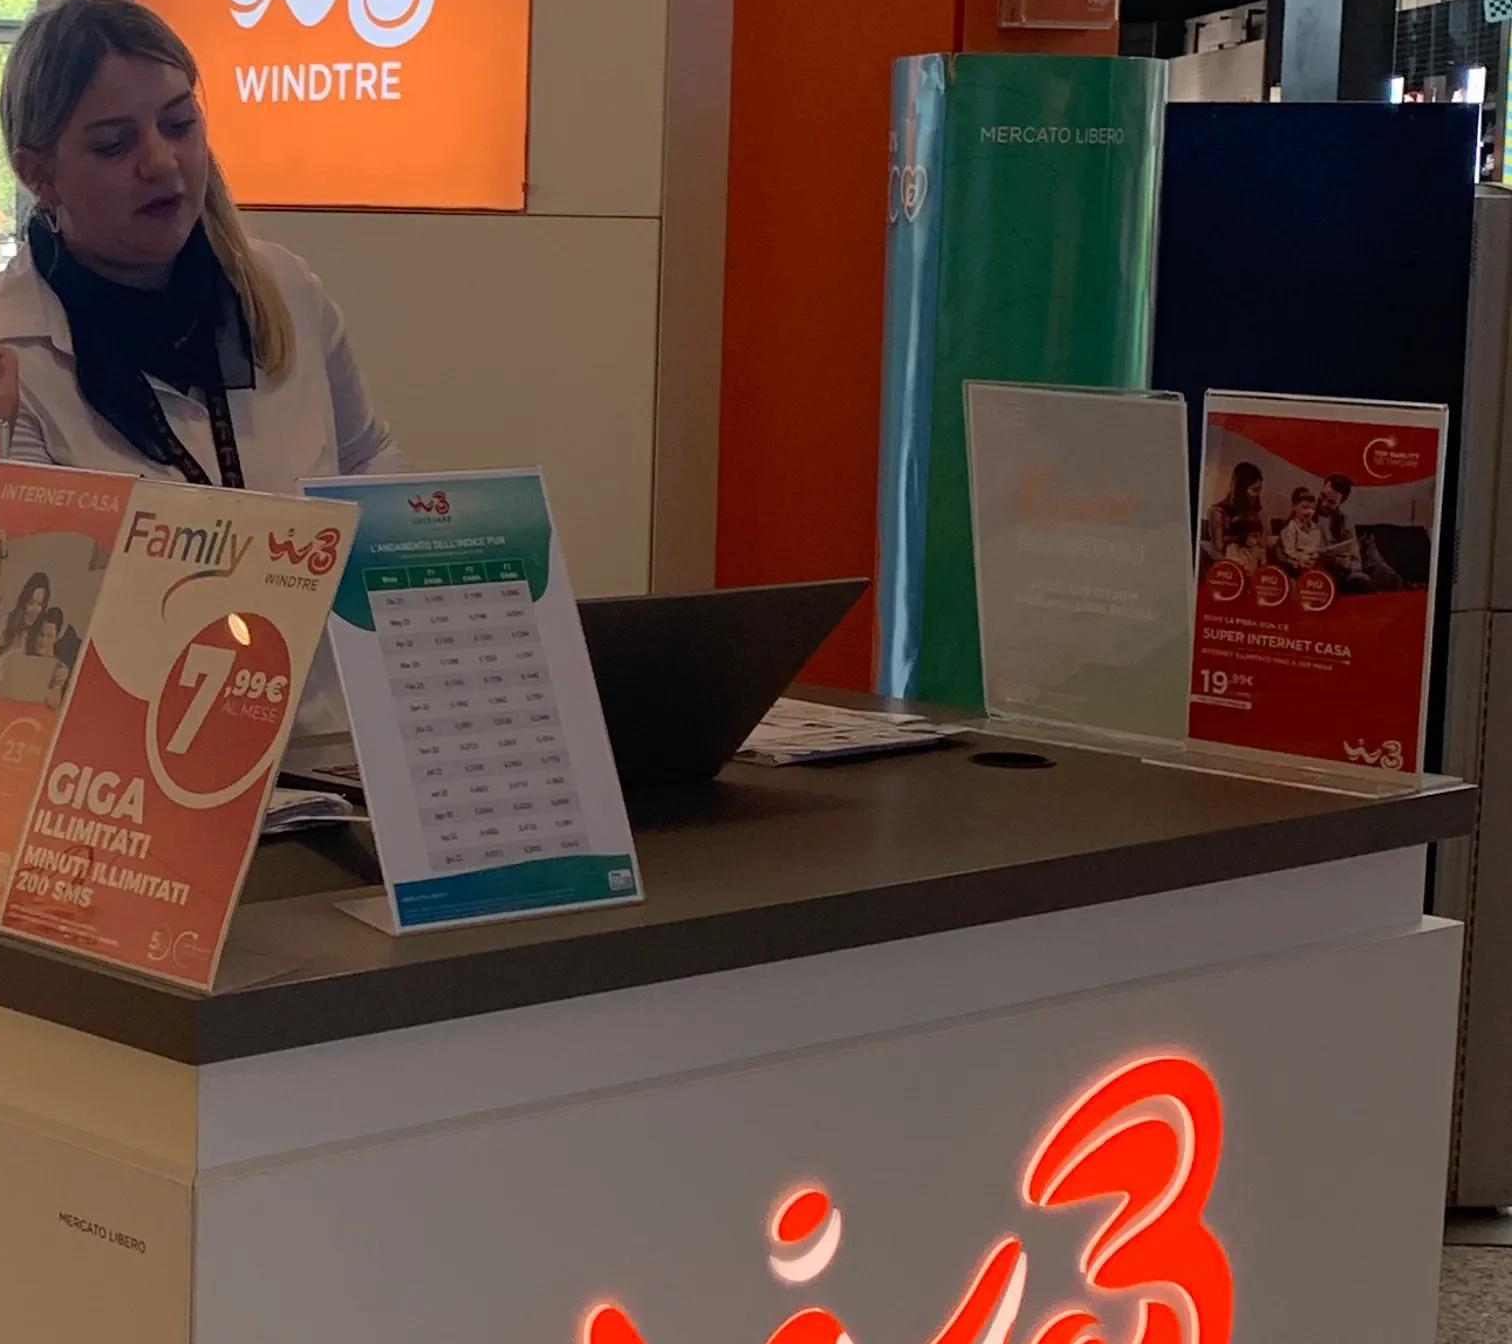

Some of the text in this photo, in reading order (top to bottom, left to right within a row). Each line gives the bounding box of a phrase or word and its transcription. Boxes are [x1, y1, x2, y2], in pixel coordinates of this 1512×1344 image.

[235, 61, 403, 103] WINDTRE
[980, 126, 1125, 145] MERCATO LIBERO
[1, 484, 75, 507] INTERNET
[78, 492, 120, 513] CASA
[123, 511, 255, 581] Family
[265, 573, 321, 592] WINDTRE
[1203, 627, 1352, 658] SUPER INTERNET CASA
[242, 702, 279, 724] MESE
[47, 758, 144, 825] GIGA
[33, 809, 152, 860] ILLIMITATI
[15, 870, 50, 896] 200
[50, 881, 95, 908] SMS
[24, 844, 191, 906] MINUTI ILLIMITATI
[59, 1211, 146, 1254] MERCATO LIBERO
